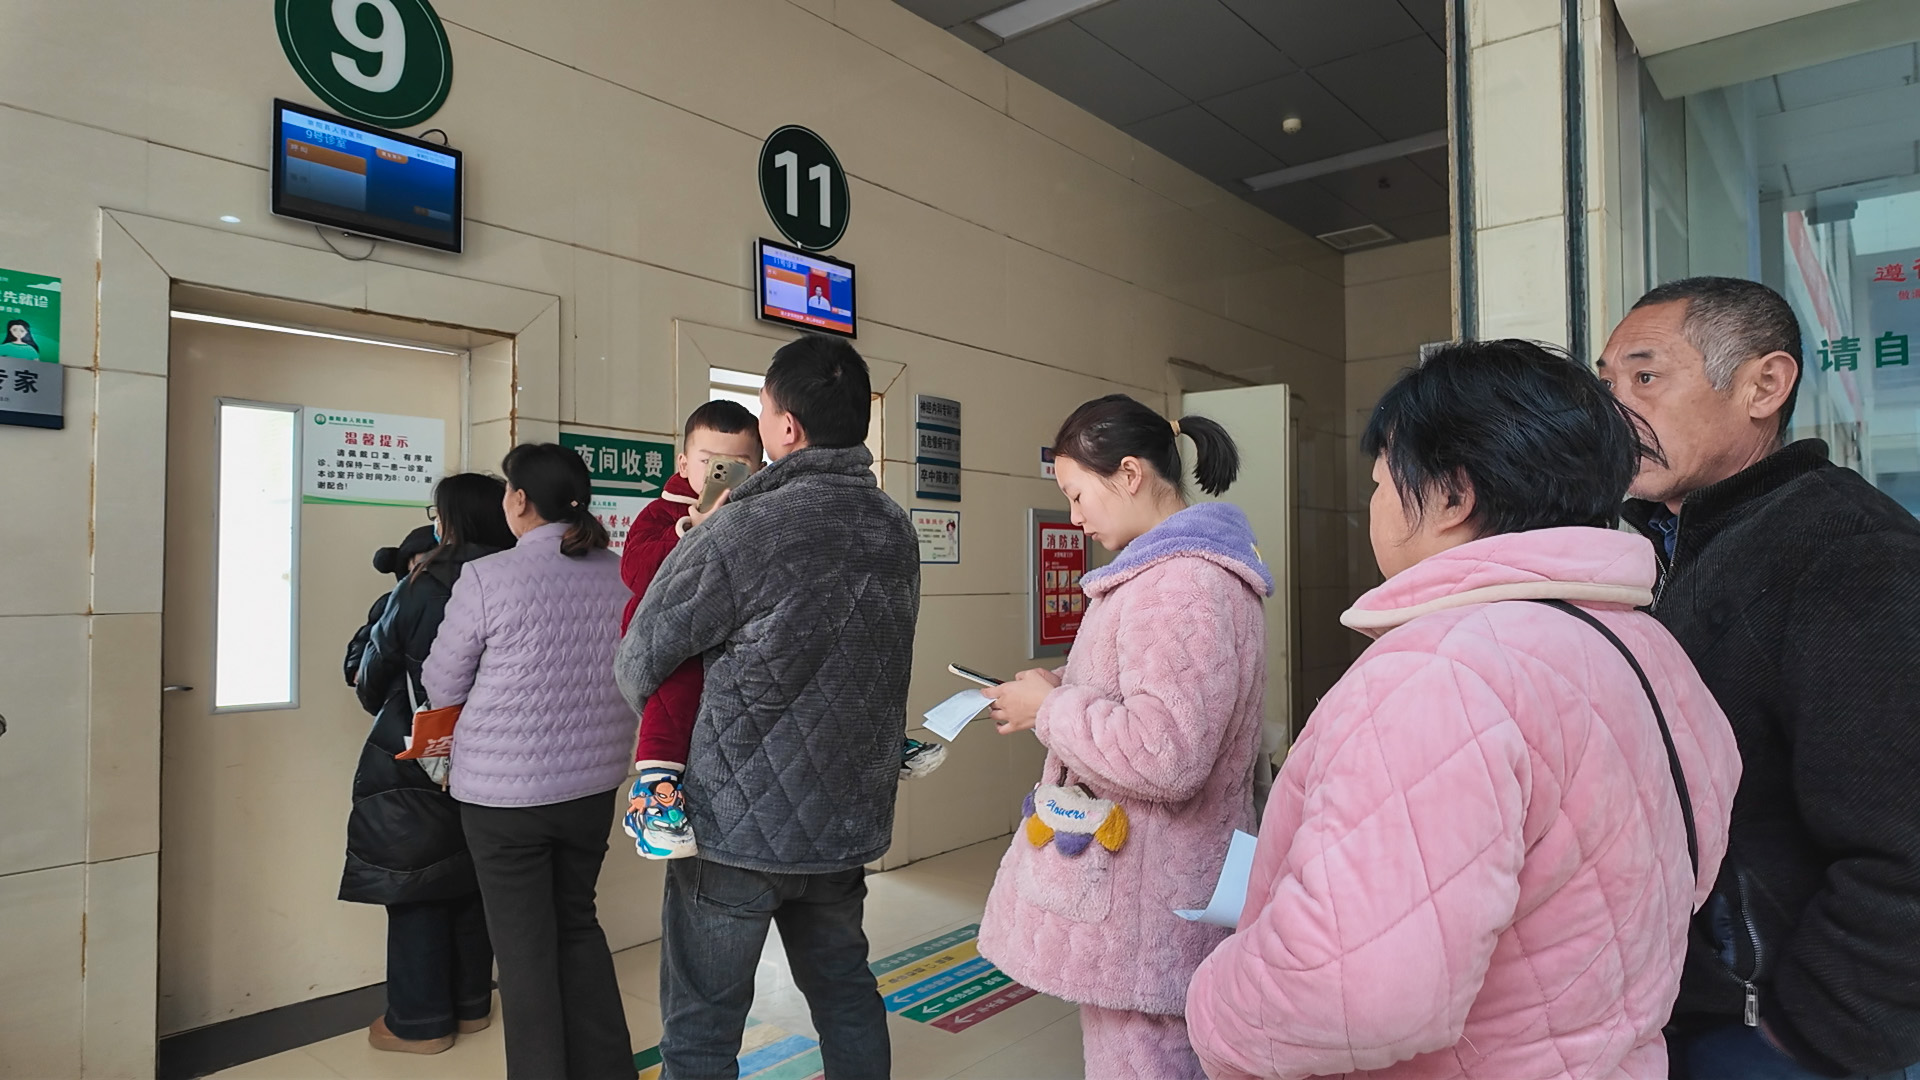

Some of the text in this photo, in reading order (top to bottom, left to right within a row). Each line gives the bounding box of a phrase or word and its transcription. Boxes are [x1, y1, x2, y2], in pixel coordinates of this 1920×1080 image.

[331, 0, 406, 92] 9
[305, 129, 348, 149] 9号诊室
[774, 150, 832, 229] 11
[1873, 258, 1920, 282] 遵
[0, 290, 49, 308] 先就诊
[1817, 331, 1909, 372] 请自
[345, 431, 409, 448] 温馨提示
[574, 444, 663, 478] 夜间收费
[920, 468, 960, 485] 卒中筛查门诊
[1046, 533, 1080, 549] 消防栓
